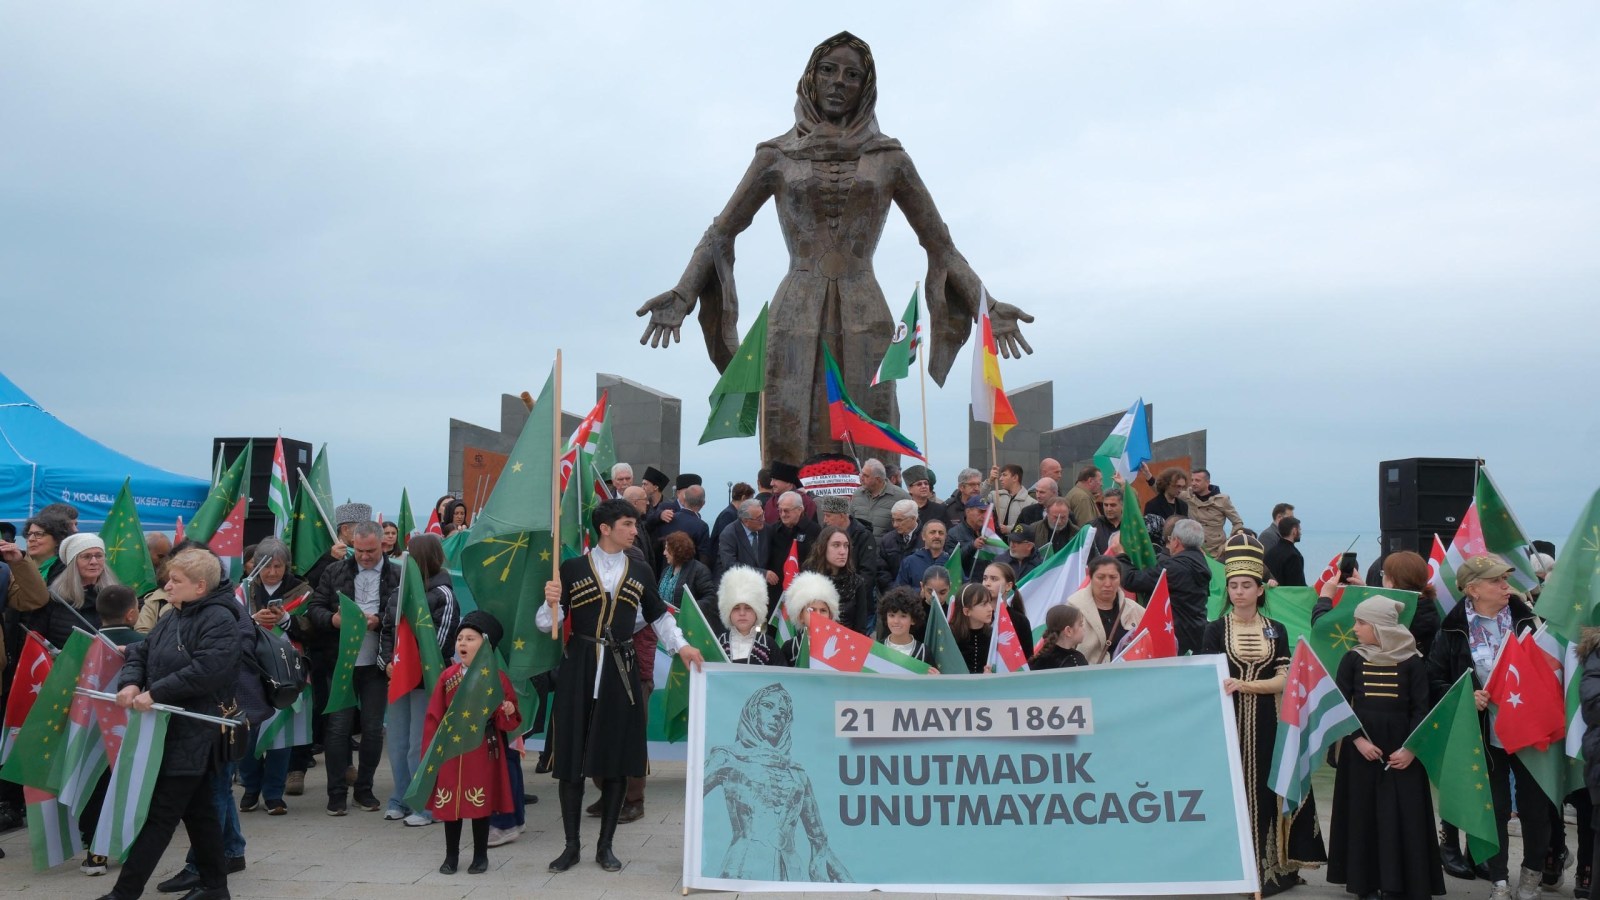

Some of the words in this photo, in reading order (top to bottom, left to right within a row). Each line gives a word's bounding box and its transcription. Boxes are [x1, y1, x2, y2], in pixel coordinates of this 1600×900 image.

[133, 495, 169, 507] ÜKŞEHİR
[840, 707, 875, 732] 21
[892, 706, 993, 732] MAYIS
[1007, 705, 1087, 731] 1864
[838, 752, 1096, 786] UNUTMADIK
[838, 781, 1207, 827] UNUTMAYACAĞIZ
